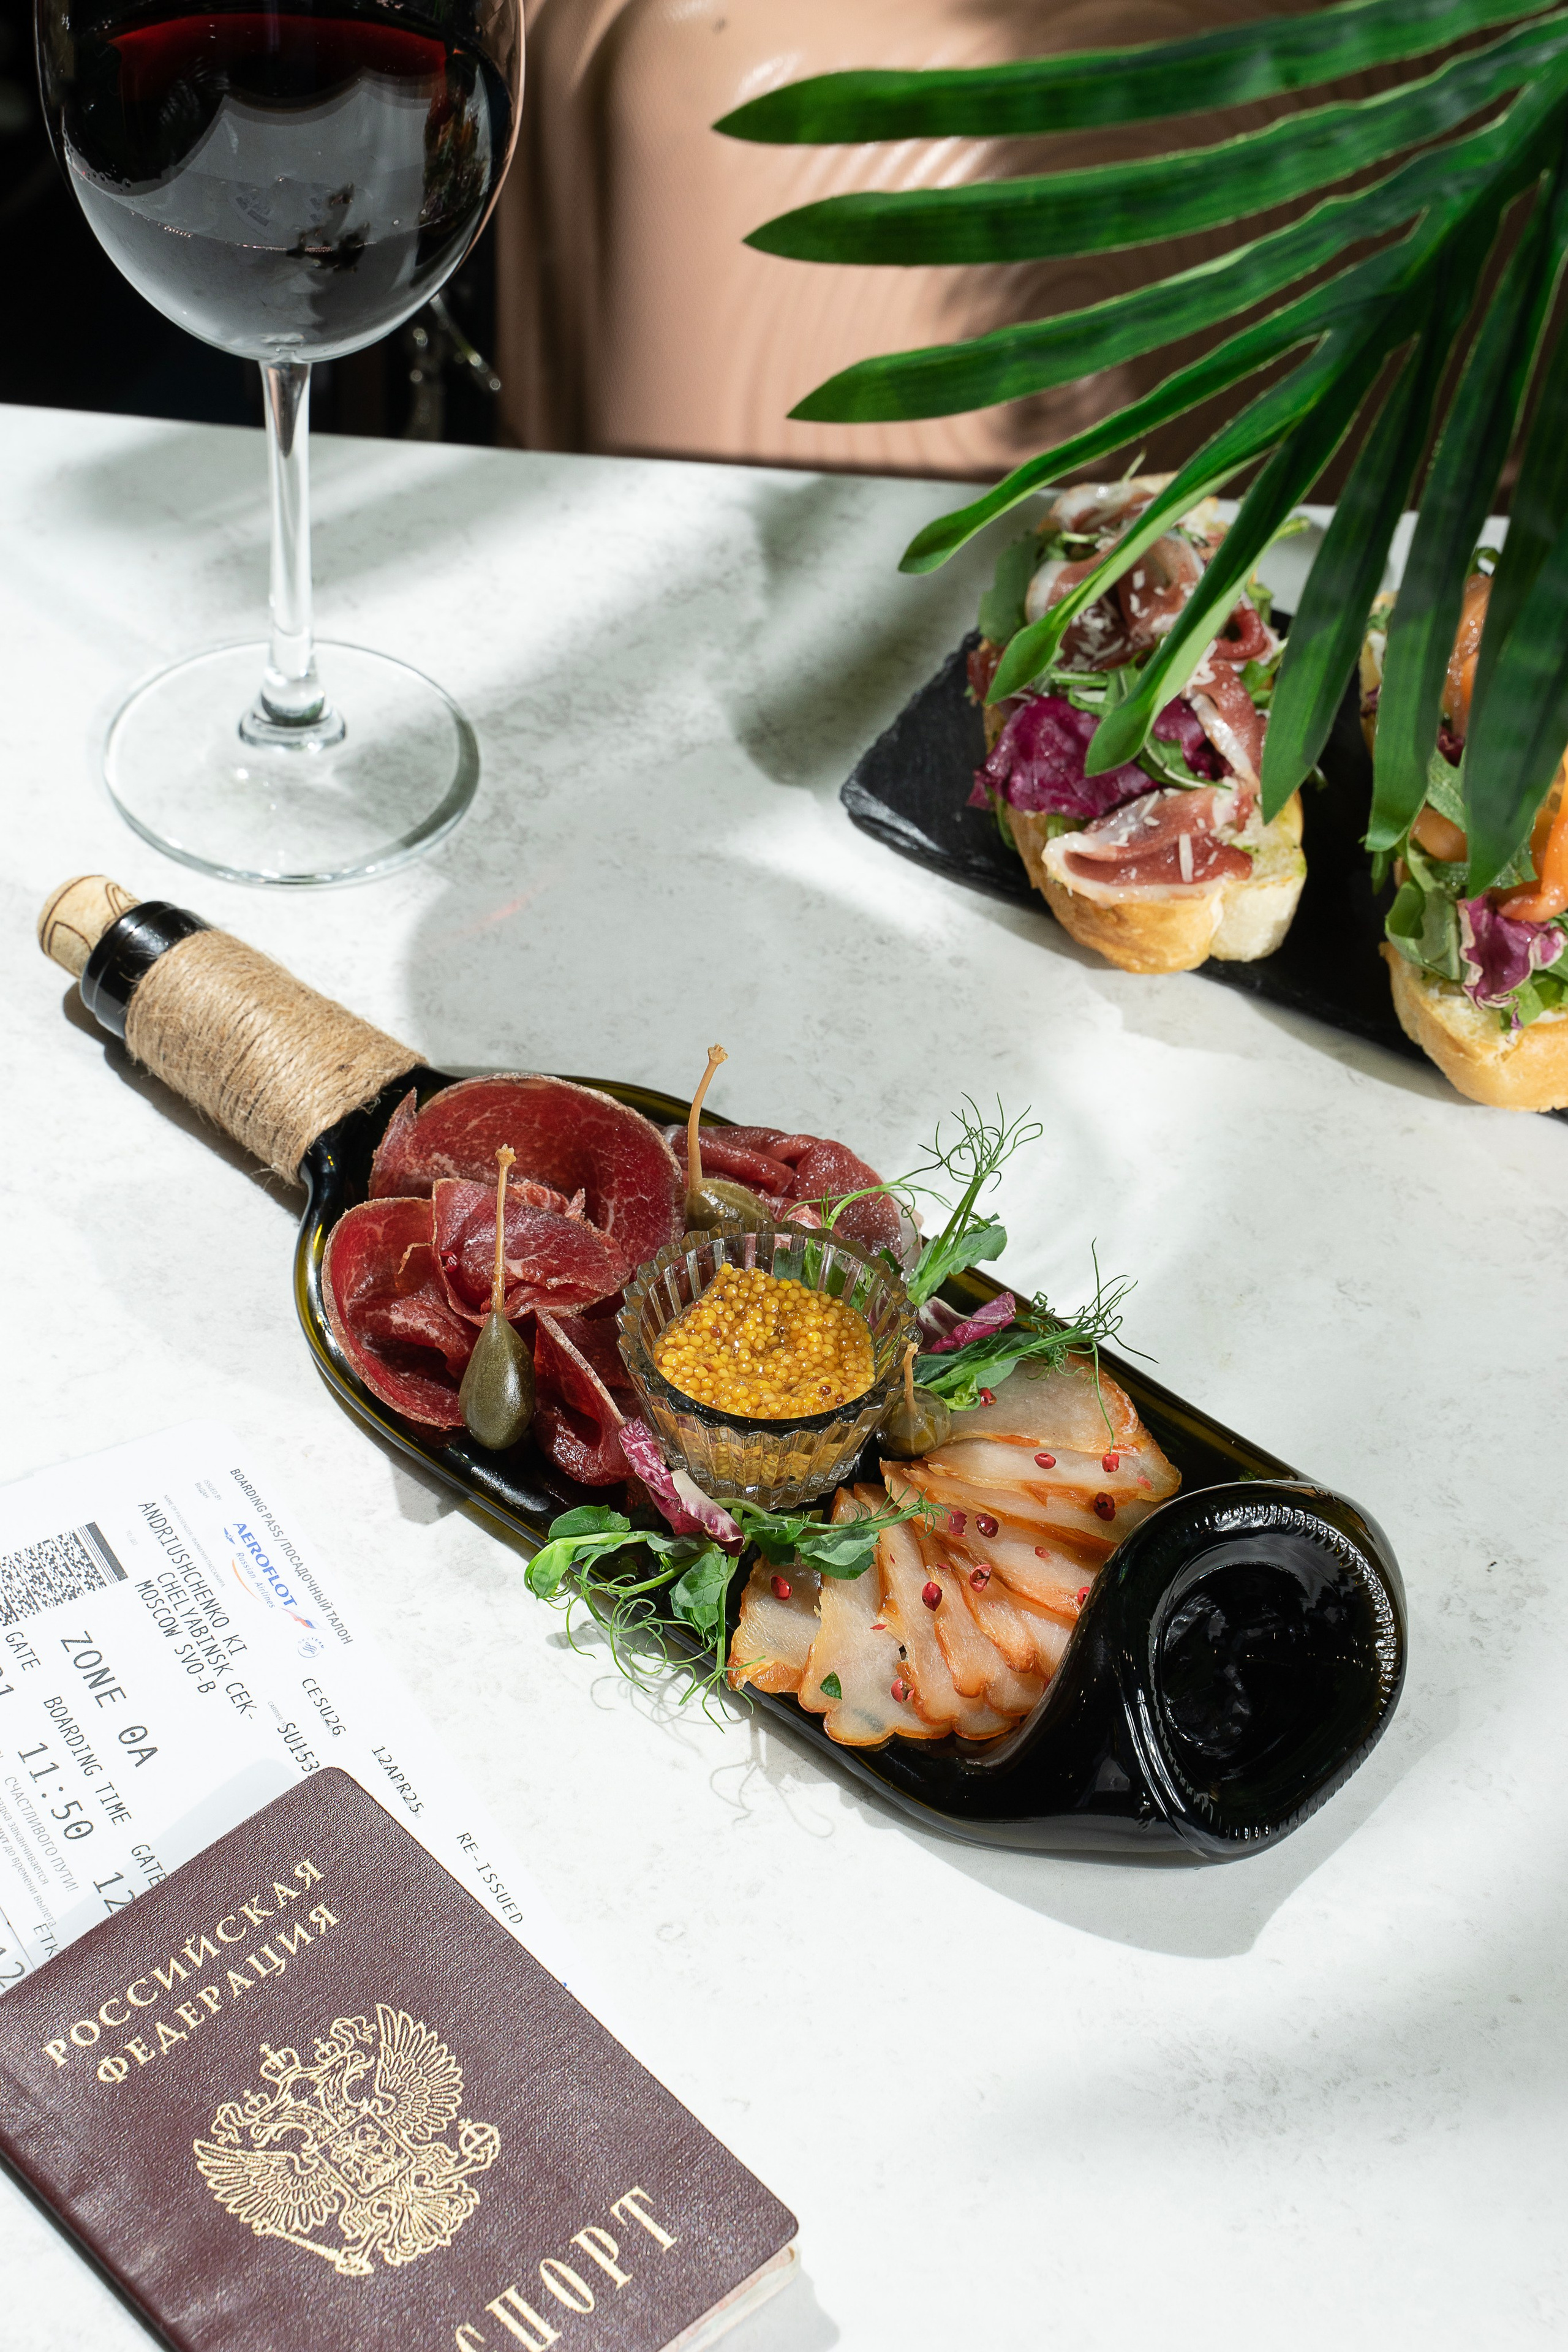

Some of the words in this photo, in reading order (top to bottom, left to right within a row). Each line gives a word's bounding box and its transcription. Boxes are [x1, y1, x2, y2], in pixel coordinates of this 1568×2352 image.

[137, 1502, 230, 1628] ANDRIUSHCHENKO
[222, 1634, 247, 1656] KI
[229, 1468, 268, 1513] BOARDING
[325, 1610, 353, 1645] ТАЛОН
[232, 1523, 298, 1606] AEROFLOT
[235, 1552, 256, 1578] Russian
[254, 1582, 275, 1608] Airlines
[5, 1631, 41, 1671] GATE
[60, 1630, 127, 1708] ZONE
[134, 1580, 183, 1637] MOSCOW
[173, 1643, 216, 1694] SVO-B
[157, 1572, 234, 1677] CHELYABINSK
[225, 1682, 257, 1719] CEK-
[276, 1722, 320, 1777] SU153
[301, 1678, 346, 1736] CESU26
[17, 1742, 94, 1840] 11:50
[43, 1695, 103, 1776] BOARDING
[95, 1781, 132, 1824] TIME
[371, 1746, 424, 1813] 12APR25
[0, 1797, 12, 1821] адка
[7, 1822, 49, 1885] заканчивается
[4, 1776, 58, 1856] СЧАСТЛИВОГО
[50, 1856, 79, 1892] ПУТИ!
[130, 1844, 167, 1887] GATE
[456, 1832, 523, 1923] RE-ISSUED
[2, 1845, 16, 1856] до
[11, 1856, 38, 1894] времени
[33, 1894, 56, 1928] вылета
[42, 1858, 325, 2068] РОССИЙСКАЯ
[97, 1903, 339, 2084] ФЕДЕРАЦИЯ
